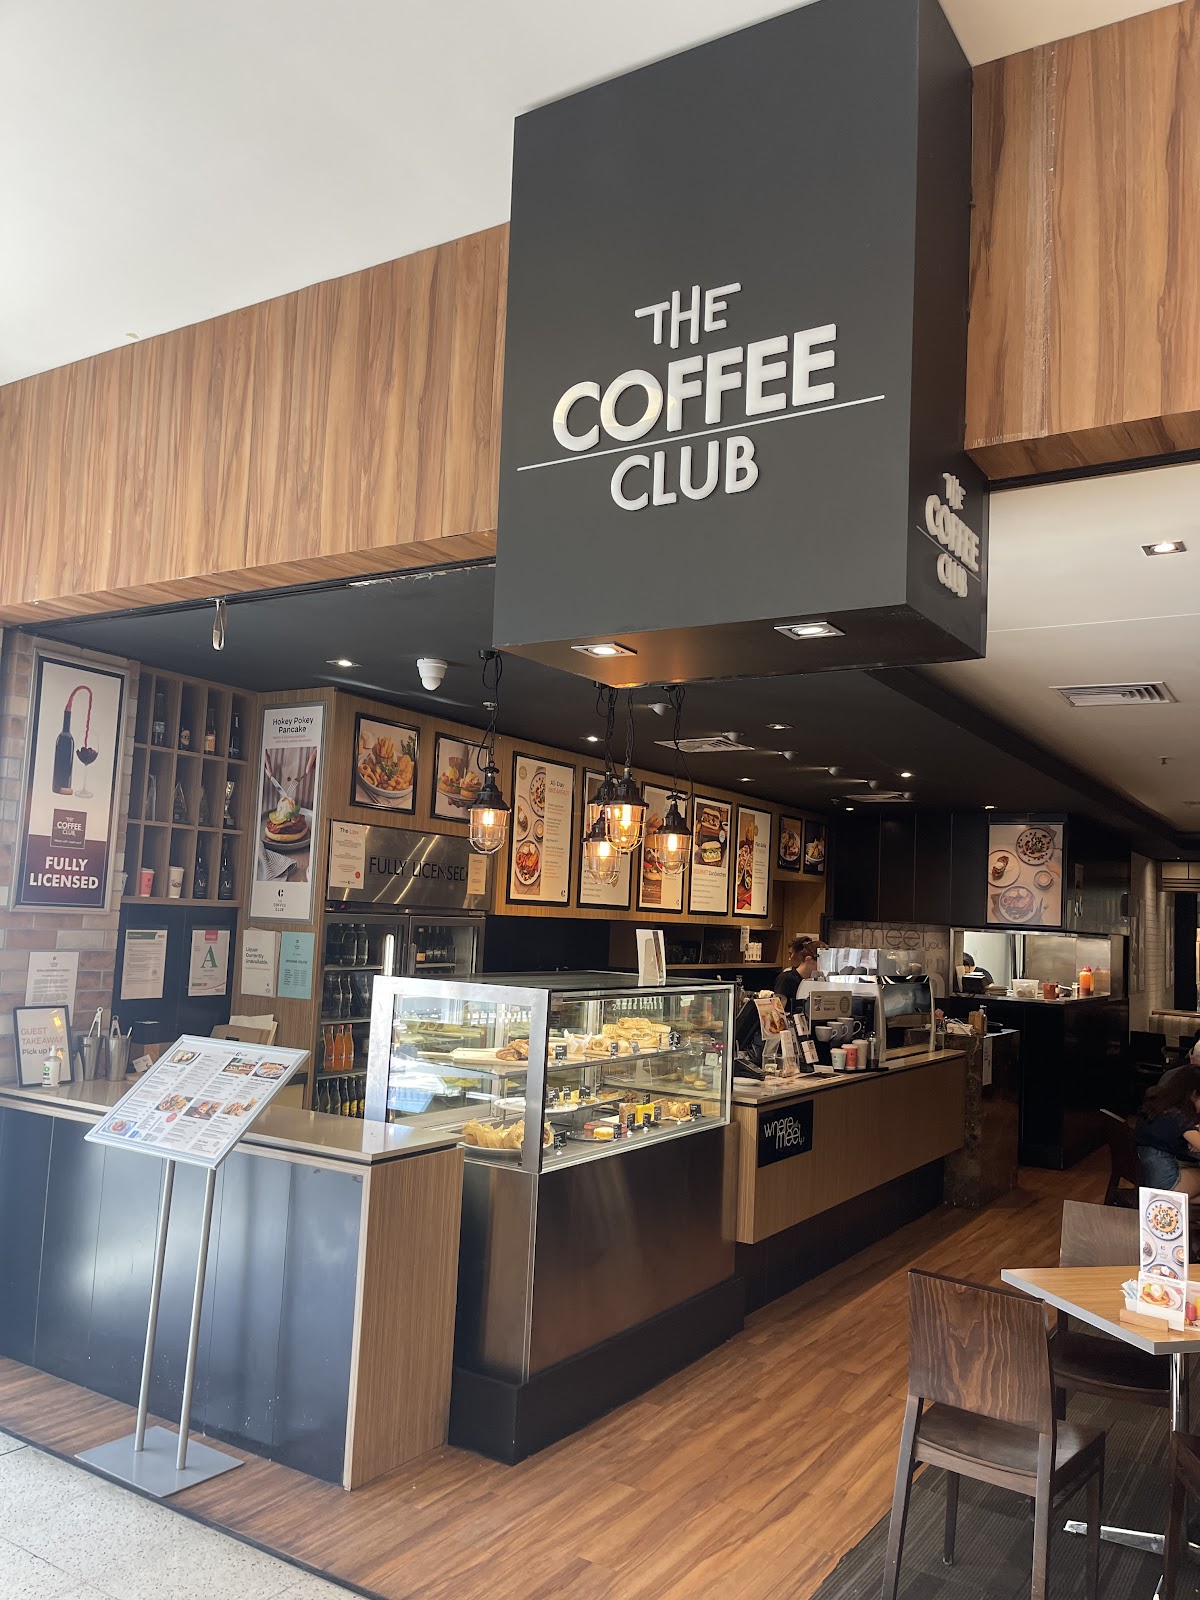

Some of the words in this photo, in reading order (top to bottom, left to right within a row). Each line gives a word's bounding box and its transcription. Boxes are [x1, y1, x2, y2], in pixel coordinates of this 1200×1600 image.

[634, 282, 742, 349] THE
[552, 323, 837, 452] COFFEE
[610, 435, 759, 512] CLUB
[942, 472, 967, 510] THE
[925, 494, 980, 573] COFFEE
[936, 553, 968, 598] CLUB
[272, 717, 292, 726] Hokey
[293, 716, 314, 725] Pokey
[278, 725, 307, 733] Pancake
[56, 821, 82, 831] COFFEE
[45, 856, 89, 872] FULLY
[369, 856, 406, 876] FULLY
[412, 861, 468, 882] LICENSED
[29, 872, 99, 889] LICENSED
[200, 945, 219, 968] A
[245, 952, 264, 960] Currently
[20, 1027, 48, 1036] GUEST
[22, 1036, 64, 1045] TAKEAWAY
[38, 1049, 47, 1057] up
